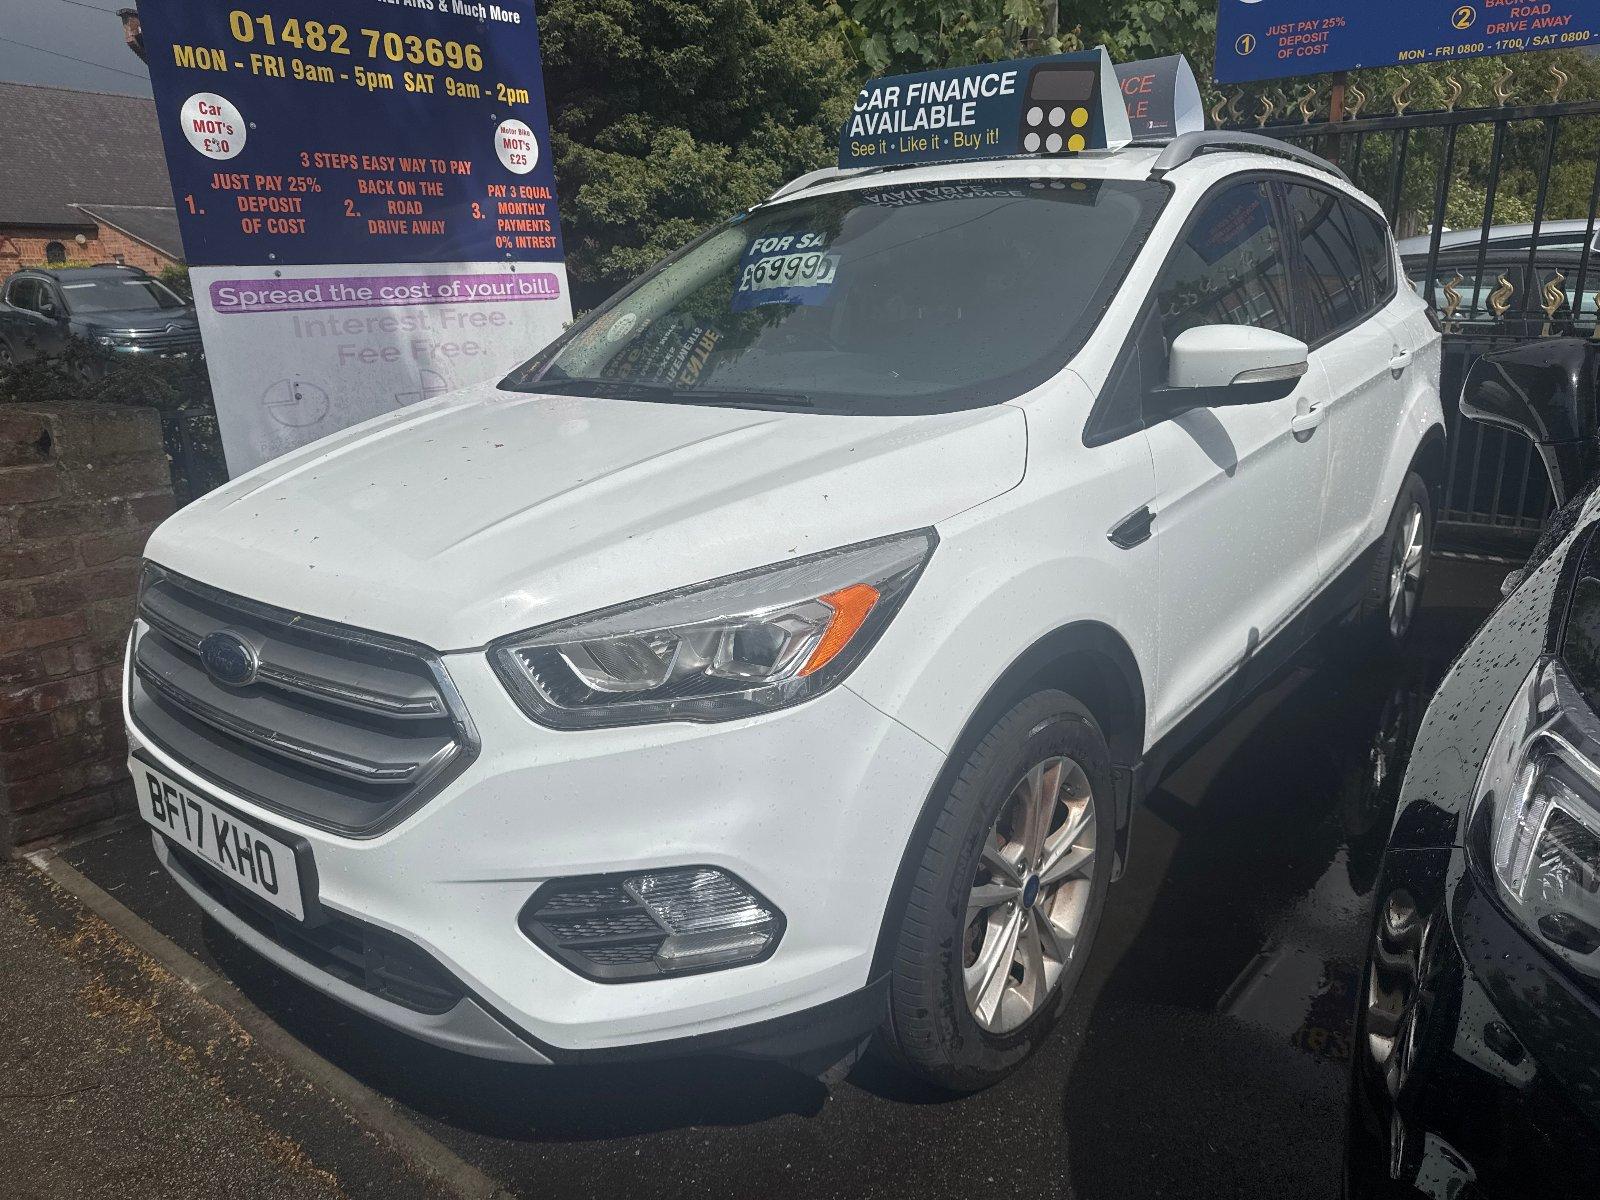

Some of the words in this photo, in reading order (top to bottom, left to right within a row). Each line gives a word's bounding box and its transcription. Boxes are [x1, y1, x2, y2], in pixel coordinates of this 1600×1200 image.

[451, 1, 487, 19] Much
[489, 5, 521, 24] More
[1456, 8, 1472, 28] 2
[1510, 3, 1551, 18] ROAD
[1265, 23, 1295, 37] JUST
[1297, 20, 1320, 32] PAY
[1322, 16, 1346, 29] 25%
[1487, 20, 1528, 35] DRIVE
[1531, 14, 1573, 29] AWAY
[229, 10, 351, 55] 01482
[361, 28, 483, 72] 703696
[1241, 35, 1251, 53] 1
[1278, 31, 1330, 47] DEPOSIT
[1398, 50, 1425, 61] MON
[1435, 46, 1454, 57] FRI
[1457, 43, 1484, 54] 0800
[1496, 39, 1523, 50] 1700
[1532, 34, 1558, 46] SAT
[1560, 30, 1590, 43] 0800
[1277, 48, 1294, 59] OF
[1296, 44, 1329, 57] COST
[173, 44, 228, 72] MON
[250, 53, 286, 78] FRI
[291, 58, 335, 83] 9am
[354, 66, 394, 92] 5pm
[403, 71, 435, 94] SAT
[445, 77, 481, 99] 9am
[496, 83, 530, 107] 2pm
[853, 86, 900, 112] CAR
[906, 70, 1018, 106] FINANCE
[198, 101, 222, 116] Car
[192, 119, 234, 135] MOT's
[849, 101, 977, 138] AVAILABLE
[500, 127, 517, 135] Motor
[518, 129, 531, 137] Bike
[503, 138, 531, 151] MOT's
[851, 140, 876, 157] See
[879, 139, 888, 155] it
[899, 136, 928, 153] Like
[931, 133, 940, 150] it
[953, 131, 982, 150] Buy
[986, 127, 1000, 145] it!
[300, 152, 310, 168] 3
[314, 153, 359, 170] STEPS
[362, 155, 395, 172] EASY
[399, 157, 427, 173] WAY
[430, 159, 447, 175] TO
[450, 160, 472, 176] PAY
[510, 154, 527, 166] £25
[211, 173, 250, 190] JUST
[255, 175, 283, 191] PAY
[288, 176, 322, 193] 25%
[358, 179, 395, 195] BACK
[399, 181, 417, 196] ON
[419, 181, 445, 197] THE
[487, 184, 507, 198] PAY
[510, 185, 518, 198] 3
[520, 186, 553, 199] EQUAL
[185, 194, 205, 215] 1.
[237, 196, 302, 213] DEPOSIT
[343, 199, 361, 217] 2.
[387, 200, 424, 215] ROAD
[471, 203, 486, 219] 3.
[497, 202, 546, 216] MONTHLY
[241, 218, 262, 234] OF
[267, 218, 306, 234] COST
[368, 219, 408, 235] DRIVE
[412, 220, 446, 235] AWAY
[497, 219, 551, 232] PAYMENTS
[495, 236, 513, 249] 0%
[515, 236, 557, 249] INTREST
[749, 235, 796, 256] FOR
[795, 232, 828, 250] SA
[218, 285, 322, 310] Spread
[329, 283, 373, 301] the
[379, 281, 432, 299] cost
[437, 280, 461, 297] of
[465, 282, 514, 300] your
[518, 278, 556, 295] bill.
[292, 309, 432, 338] Interest
[439, 307, 514, 330] Free.
[337, 341, 401, 366] Fee
[145, 770, 204, 850] BF17
[212, 812, 279, 896] KHO
